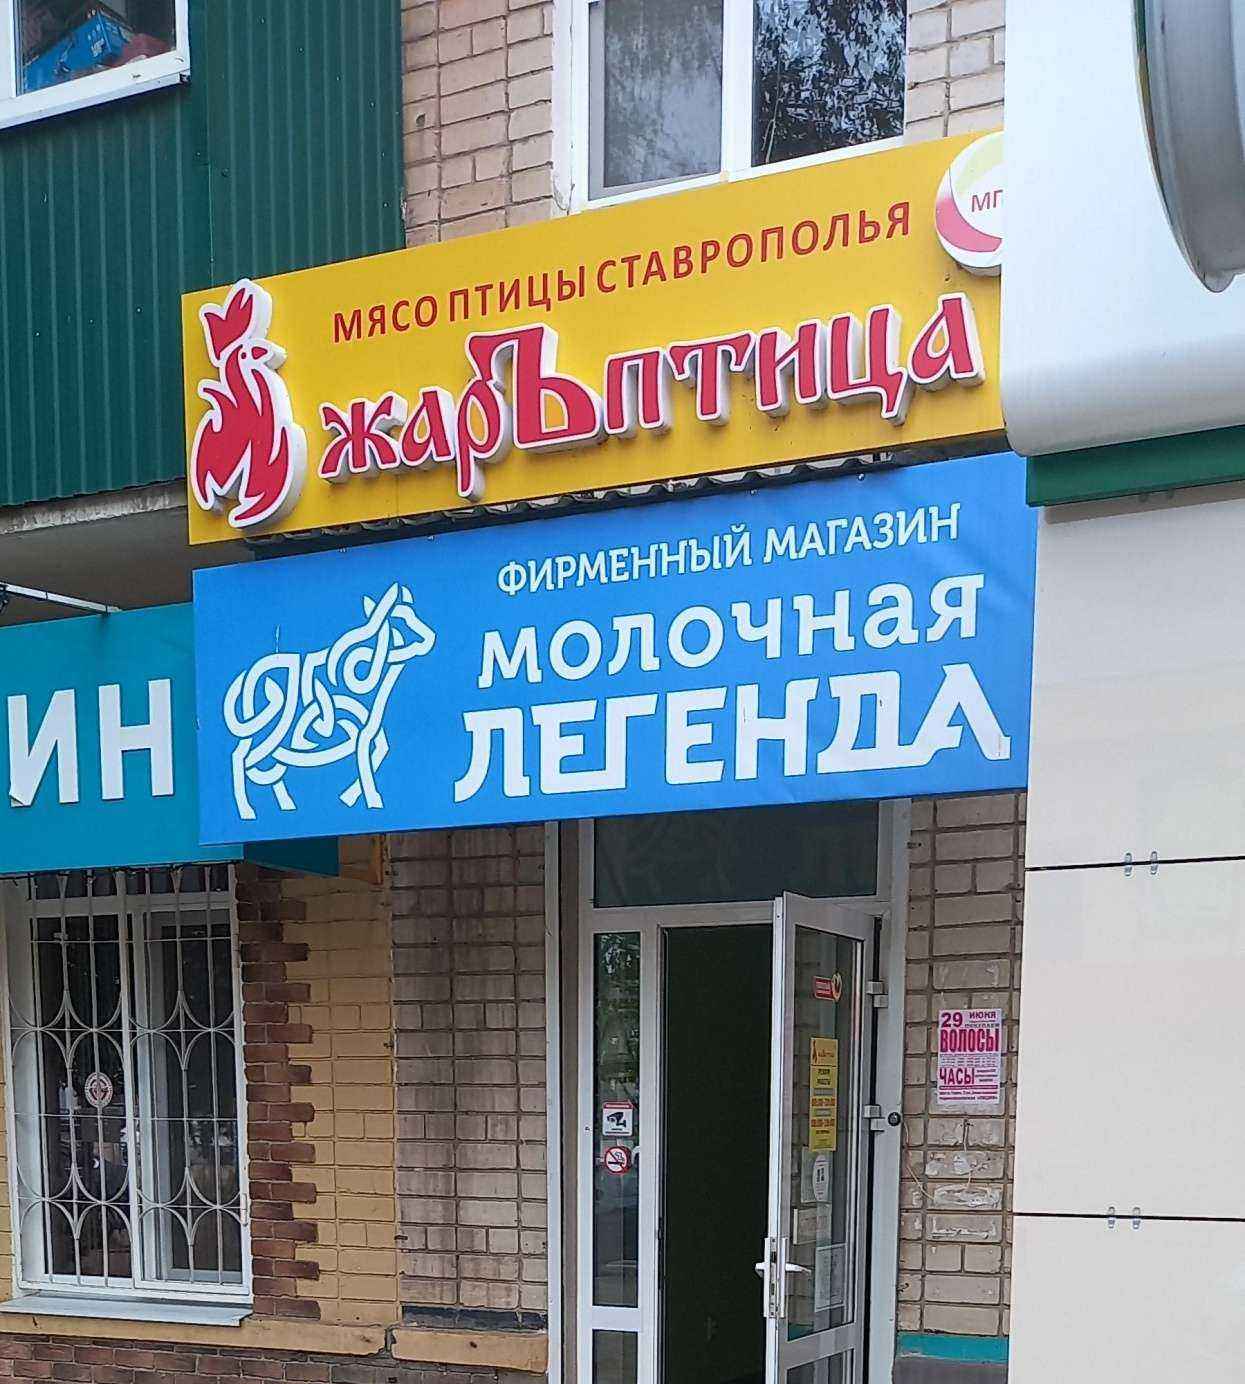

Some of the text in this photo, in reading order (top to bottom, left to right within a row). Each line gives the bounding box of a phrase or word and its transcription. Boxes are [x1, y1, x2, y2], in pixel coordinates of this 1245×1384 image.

[333, 201, 912, 343] МЯСО ПТИЦЫ СТАВРОПОЛЬЯ
[497, 502, 962, 597] ФИРМЕННЫЙ МАГАЗИН
[8, 678, 174, 807] ИН
[453, 663, 1012, 804] ЛЕГЕНДА
[940, 1029, 999, 1052] ВОЛОСЫ
[941, 1012, 963, 1028] 29
[940, 1068, 974, 1084] ЧАСЫ
